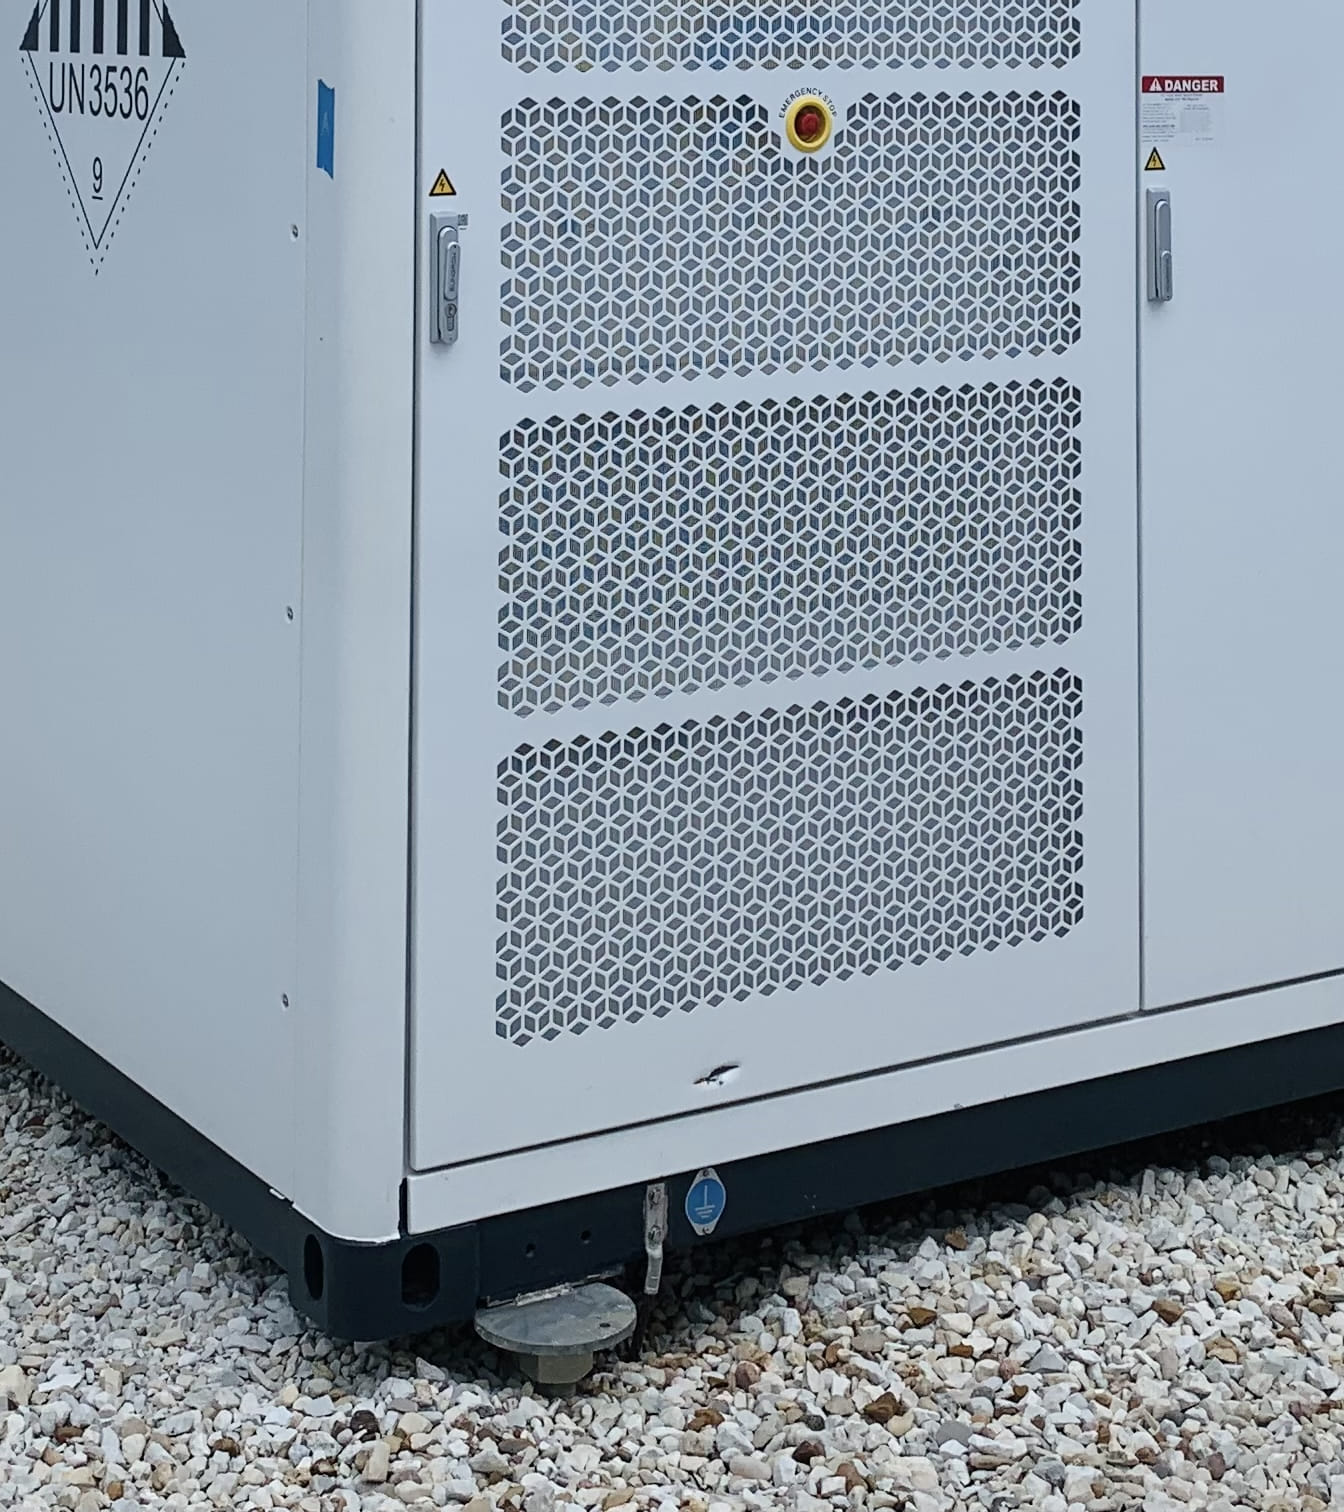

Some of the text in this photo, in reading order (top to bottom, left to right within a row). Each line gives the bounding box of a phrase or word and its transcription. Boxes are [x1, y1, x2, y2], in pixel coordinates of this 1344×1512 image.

[49, 62, 149, 121] UN3536
[1164, 79, 1218, 92] DANGER
[778, 88, 822, 118] EMERGENCY
[92, 156, 103, 193] 9
